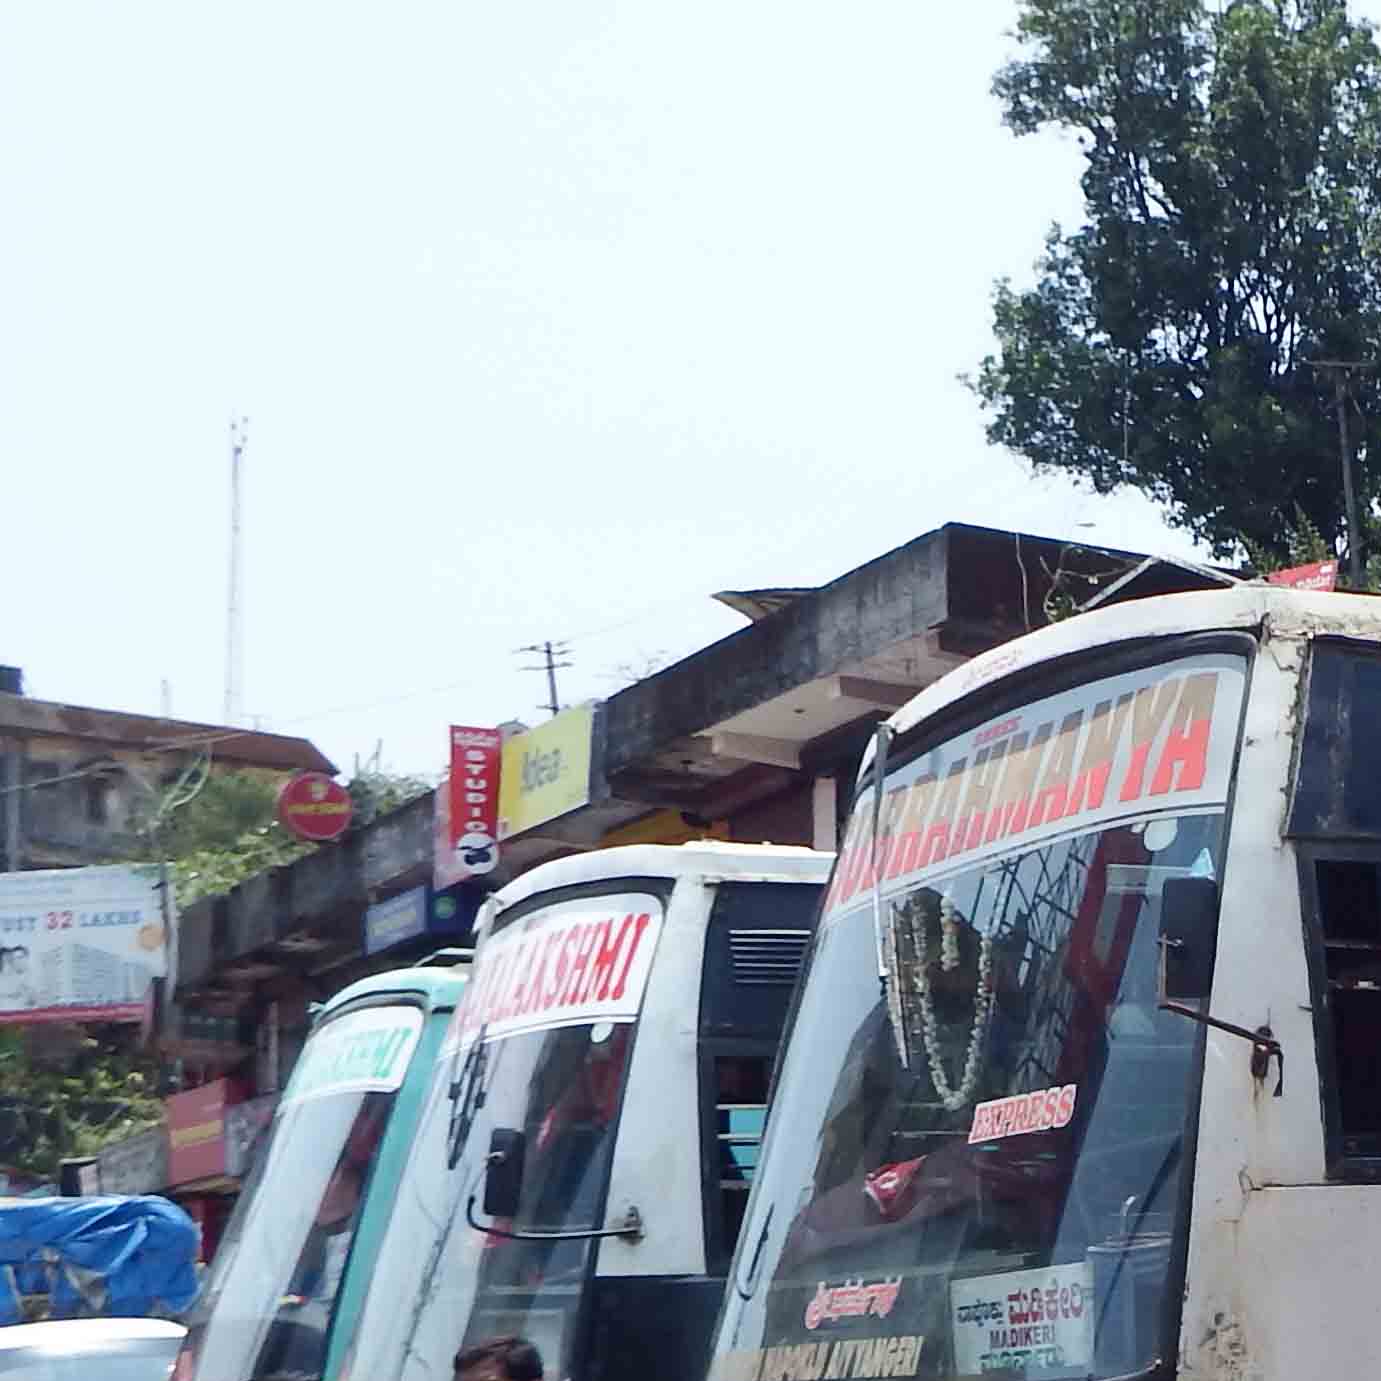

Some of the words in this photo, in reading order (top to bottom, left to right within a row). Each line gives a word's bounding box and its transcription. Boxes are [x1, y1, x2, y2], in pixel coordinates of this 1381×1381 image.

[465, 749, 488, 833] STUDIO
[47, 911, 74, 930] 32
[970, 1086, 1075, 1142] EXPRESS
[989, 1324, 1057, 1350] MADIKERI
